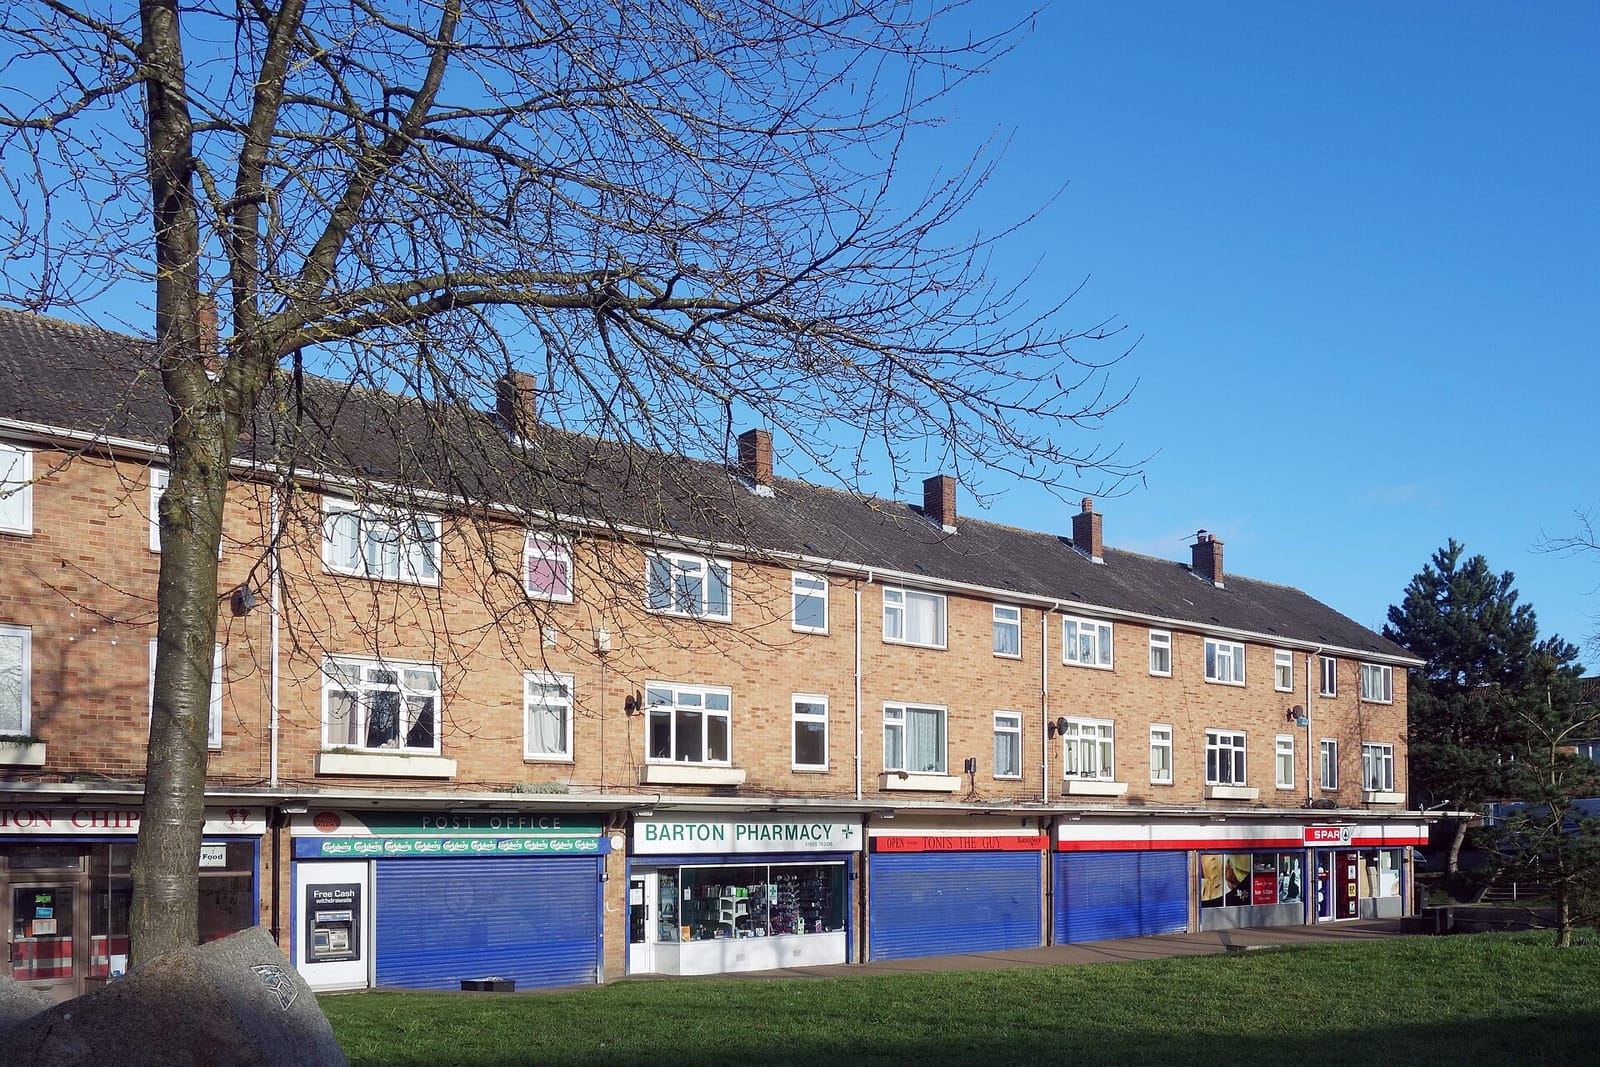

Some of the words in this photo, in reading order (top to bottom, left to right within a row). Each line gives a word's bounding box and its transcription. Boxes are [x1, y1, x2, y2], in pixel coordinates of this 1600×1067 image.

[71, 810, 143, 828] CHIP
[422, 816, 474, 829] POST
[489, 816, 561, 829] OFFICE
[645, 824, 725, 841] BARTON
[736, 824, 833, 841] PHARMACY
[1314, 830, 1340, 839] SPAR
[322, 842, 351, 853] Carlsberg
[354, 841, 382, 853] Carlsberg
[384, 840, 412, 853] Carlsberg
[414, 841, 441, 853] Carlsberg
[443, 841, 469, 851] Carlsberg
[470, 840, 496, 851] Carlsberg
[524, 840, 548, 850] Carlsberg
[550, 840, 573, 850] Carlsberg
[575, 840, 598, 850] Carlsberg
[886, 837, 905, 849] OPEN
[959, 836, 977, 849] THE
[982, 836, 1002, 849] GUY
[313, 890, 333, 898] Free
[334, 889, 355, 897] Cash
